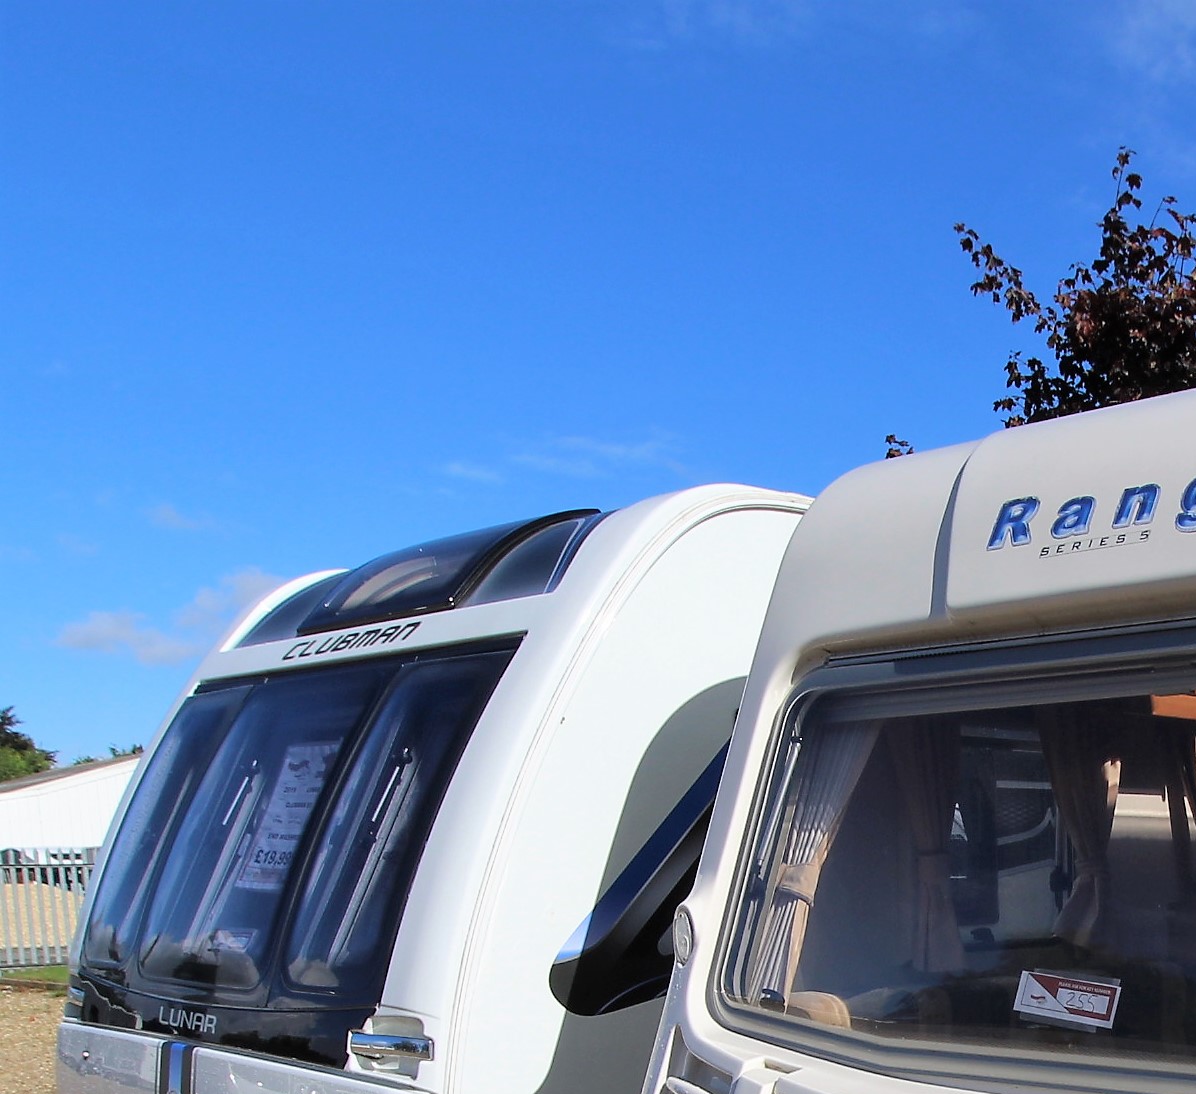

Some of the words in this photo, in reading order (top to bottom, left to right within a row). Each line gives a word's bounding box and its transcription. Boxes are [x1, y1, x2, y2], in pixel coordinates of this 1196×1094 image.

[1040, 534, 1126, 556] SERIES
[1140, 530, 1151, 540] 5
[281, 621, 422, 661] CLUBMAN
[1066, 991, 1098, 1012] 255
[159, 1006, 217, 1034] LUNAR
